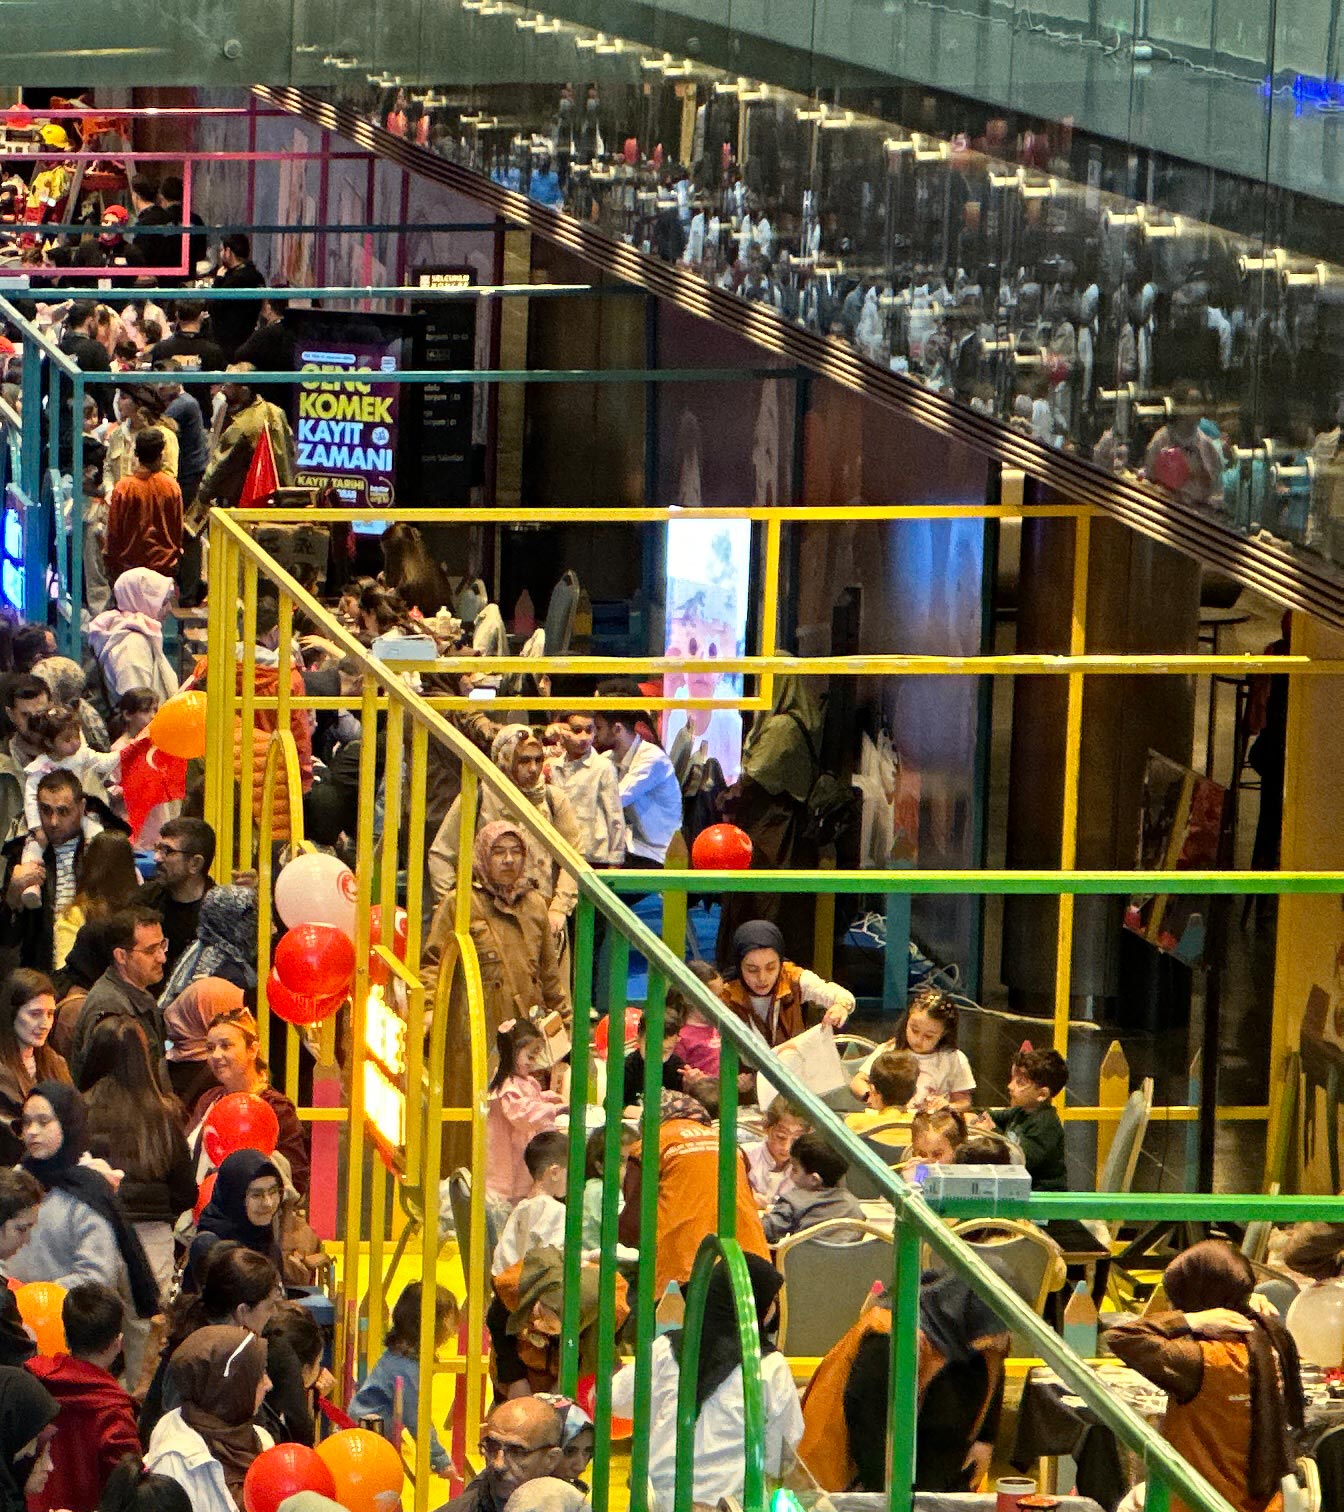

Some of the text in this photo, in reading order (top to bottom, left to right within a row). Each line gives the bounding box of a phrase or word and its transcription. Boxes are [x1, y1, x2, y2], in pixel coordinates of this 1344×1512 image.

[298, 392, 394, 424] KOMEK
[298, 419, 364, 446] KAYIT
[296, 442, 393, 472] ZAMANI
